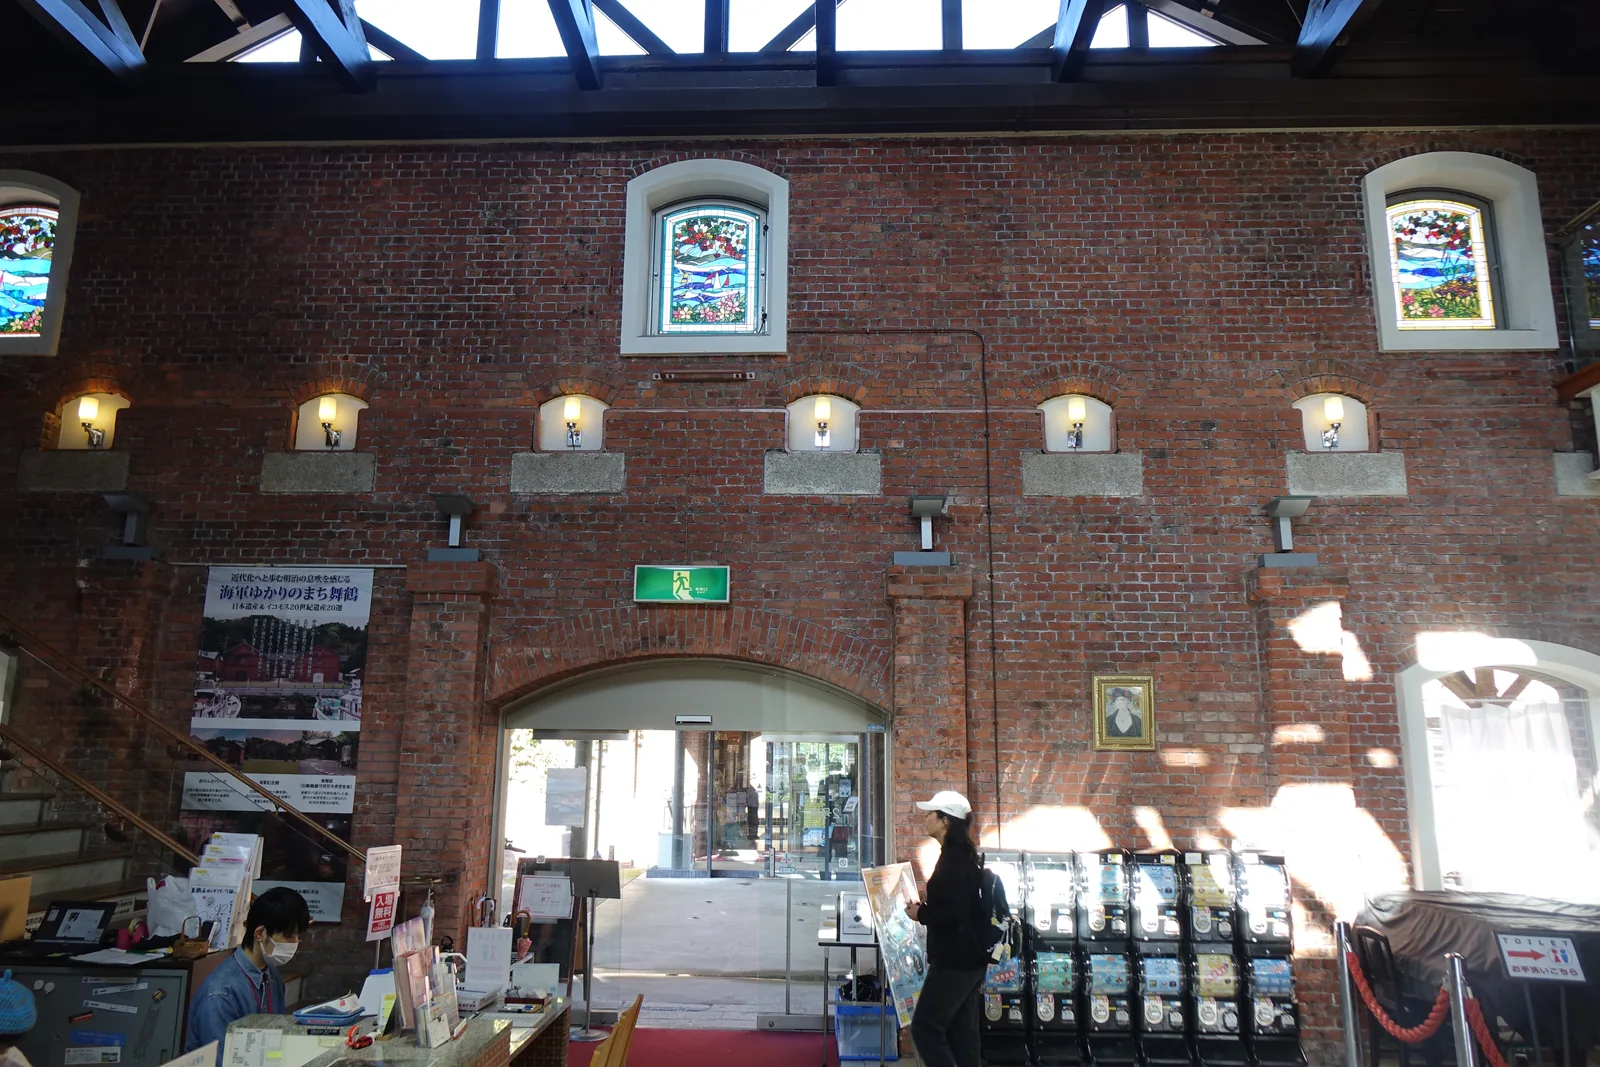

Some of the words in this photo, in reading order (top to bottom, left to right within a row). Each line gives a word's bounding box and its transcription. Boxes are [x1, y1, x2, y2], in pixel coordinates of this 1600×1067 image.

[230, 573, 351, 584] 近代化へと歩む明治の息吹を感じる
[219, 585, 359, 603] 海軍ゆかりのまち舞鶴
[376, 894, 394, 908] 入場
[374, 906, 391, 919] 無料
[1502, 937, 1569, 946] TOILET
[1511, 965, 1579, 976] お手洗いこちら
